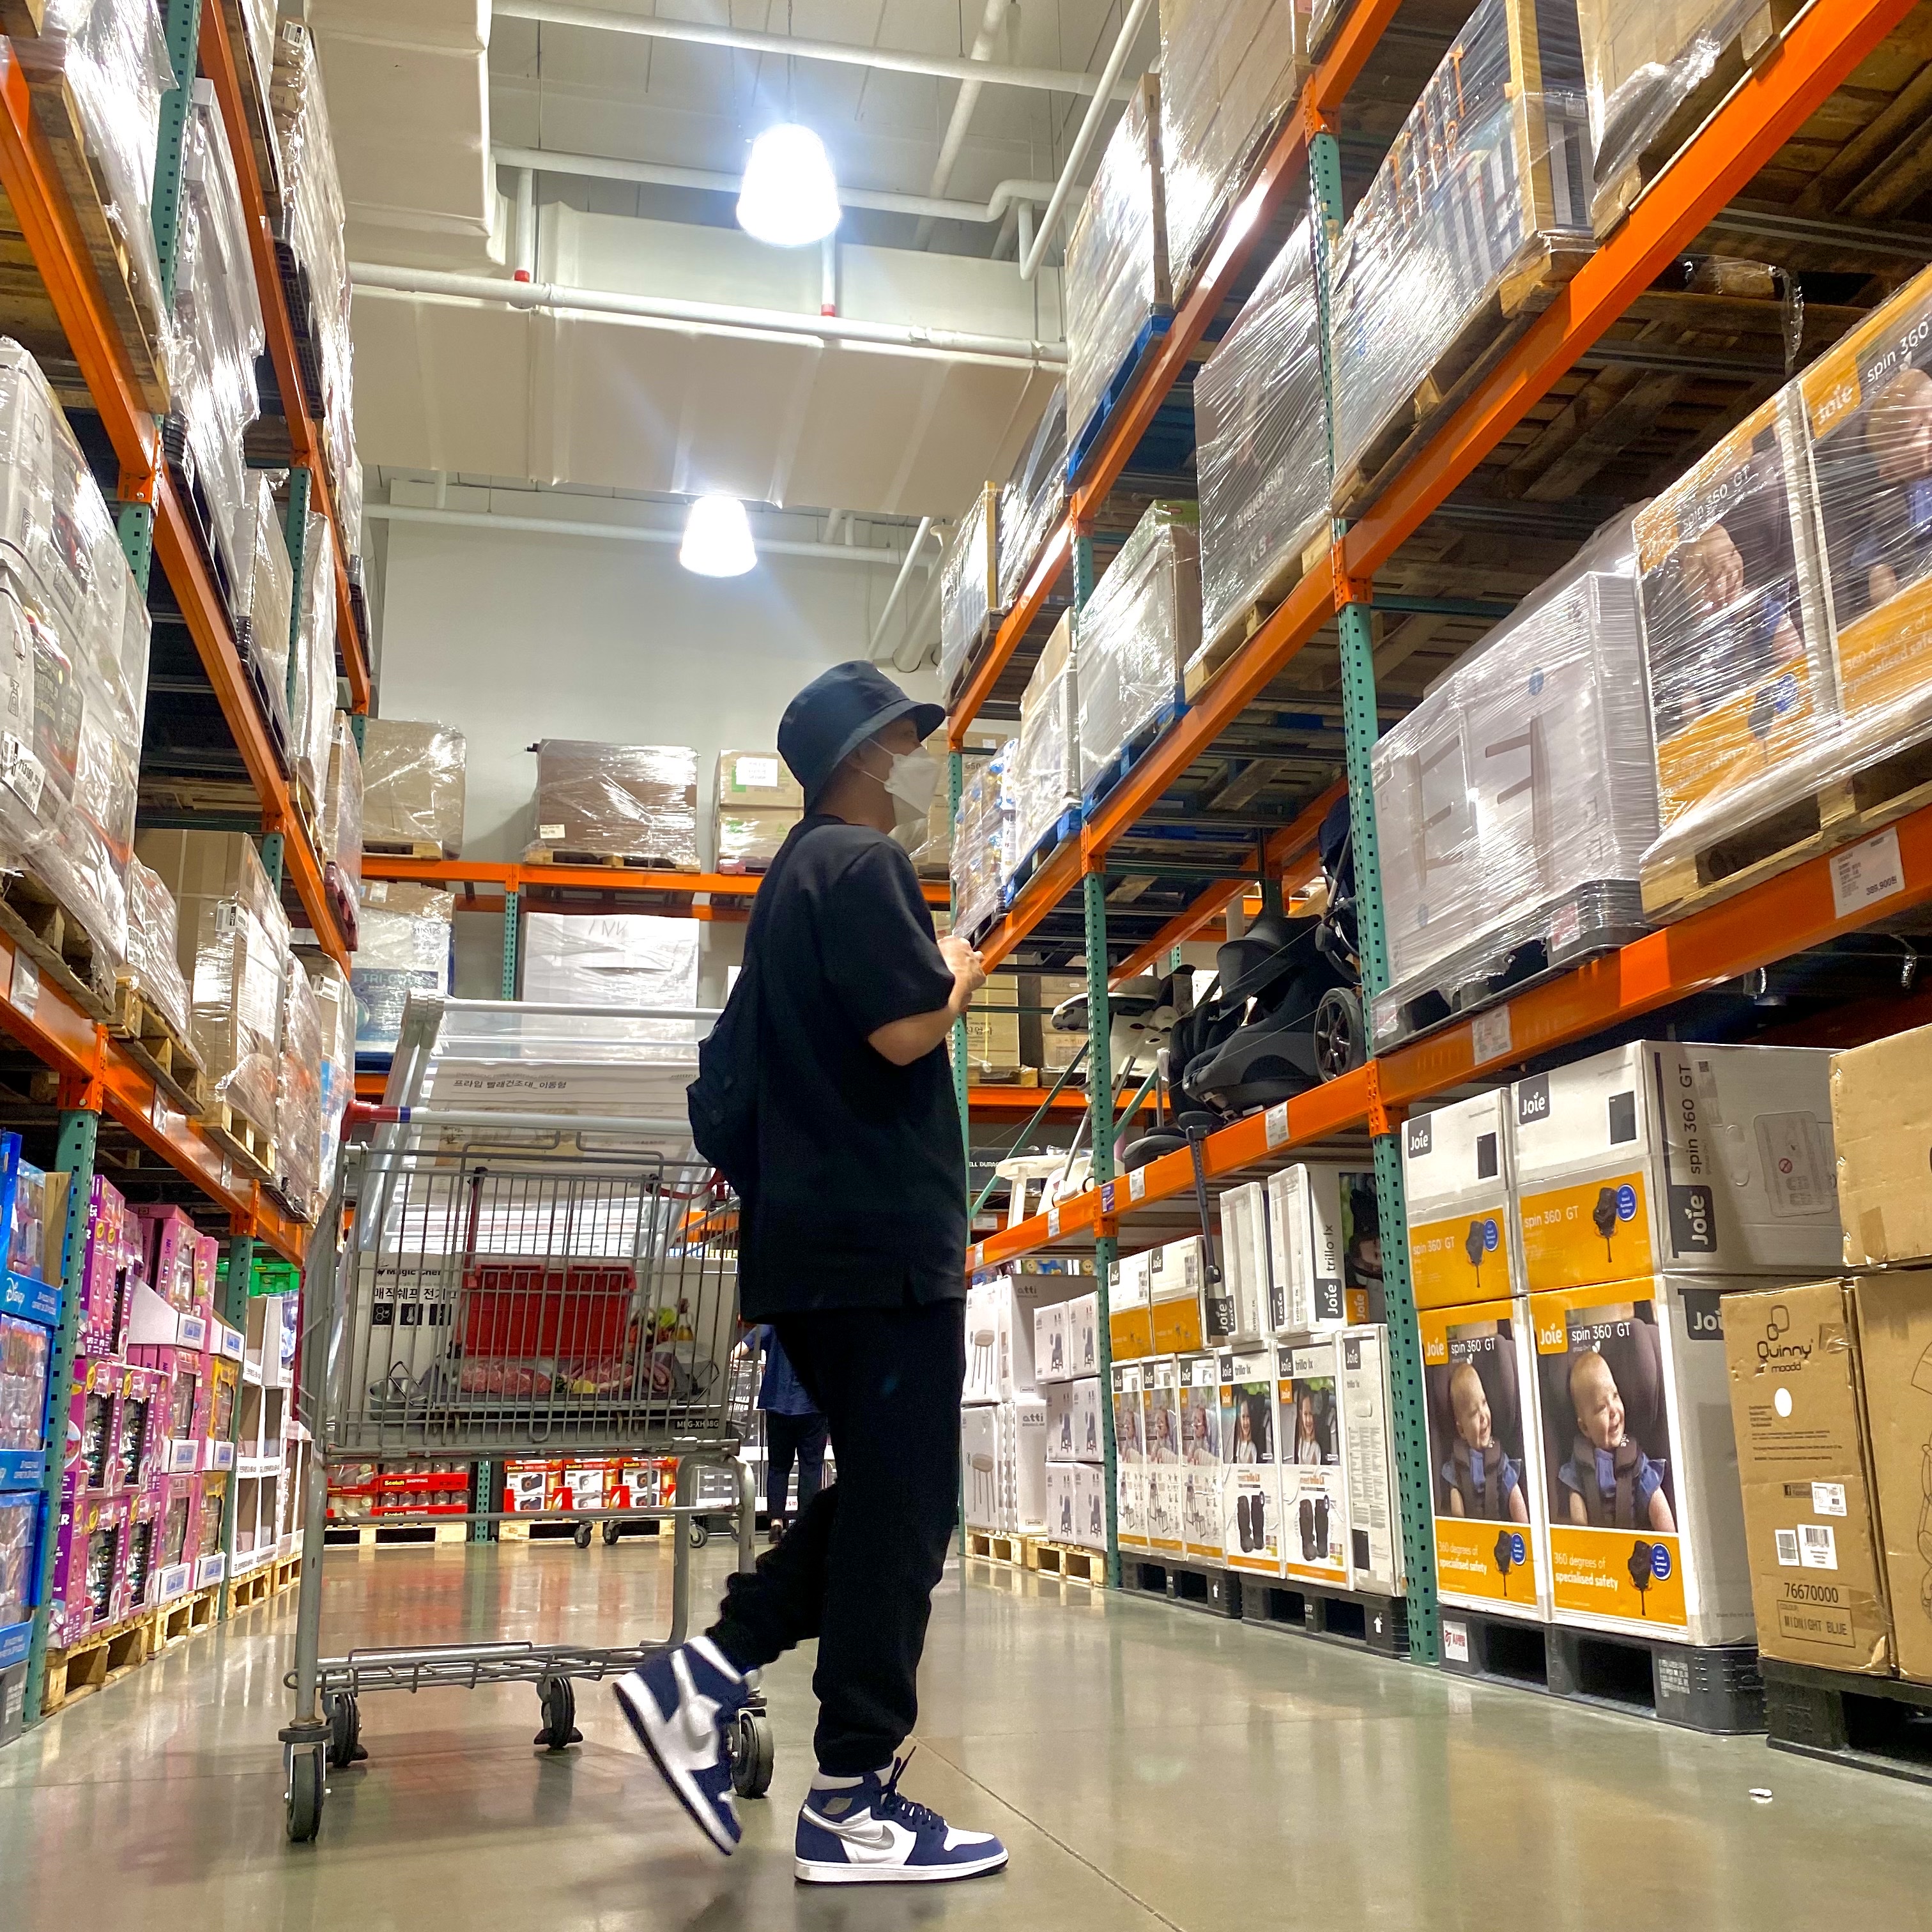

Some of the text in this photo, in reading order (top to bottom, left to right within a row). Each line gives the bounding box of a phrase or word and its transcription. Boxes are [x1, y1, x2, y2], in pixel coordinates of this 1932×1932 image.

[1867, 321, 1929, 383] spin 360
[454, 1079, 483, 1089] 프라임
[1521, 1091, 1545, 1116] Joie
[1679, 1063, 1703, 1174] spin 360 GT
[1410, 1130, 1429, 1151] Joie
[1524, 1206, 1579, 1229] spin 360 GT
[1685, 1195, 1708, 1246] Joie
[1324, 1241, 1335, 1271] trillo
[1413, 1236, 1455, 1256] spin 360 GT
[6, 1277, 25, 1312] Disney
[1018, 1285, 1037, 1294] atti
[1324, 1284, 1338, 1314] Joie
[1217, 1303, 1229, 1331] Joie
[1354, 1294, 1365, 1319] Joie
[1694, 1310, 1723, 1331] Joi
[1540, 1322, 1630, 1346] Joie spin 360 GT
[1347, 1349, 1358, 1364] Joie
[1427, 1337, 1496, 1358] Joie spin 360 GT
[1757, 1341, 1812, 1363] Quinny
[1280, 1358, 1292, 1372] Joie
[1023, 1413, 1043, 1422] atti
[1554, 1552, 1606, 1570] 360 degrees of
[1555, 1570, 1618, 1591] specialised safety
[1784, 1582, 1839, 1603] 76670000
[1784, 1615, 1848, 1636] MIDNIGHT BLUE
